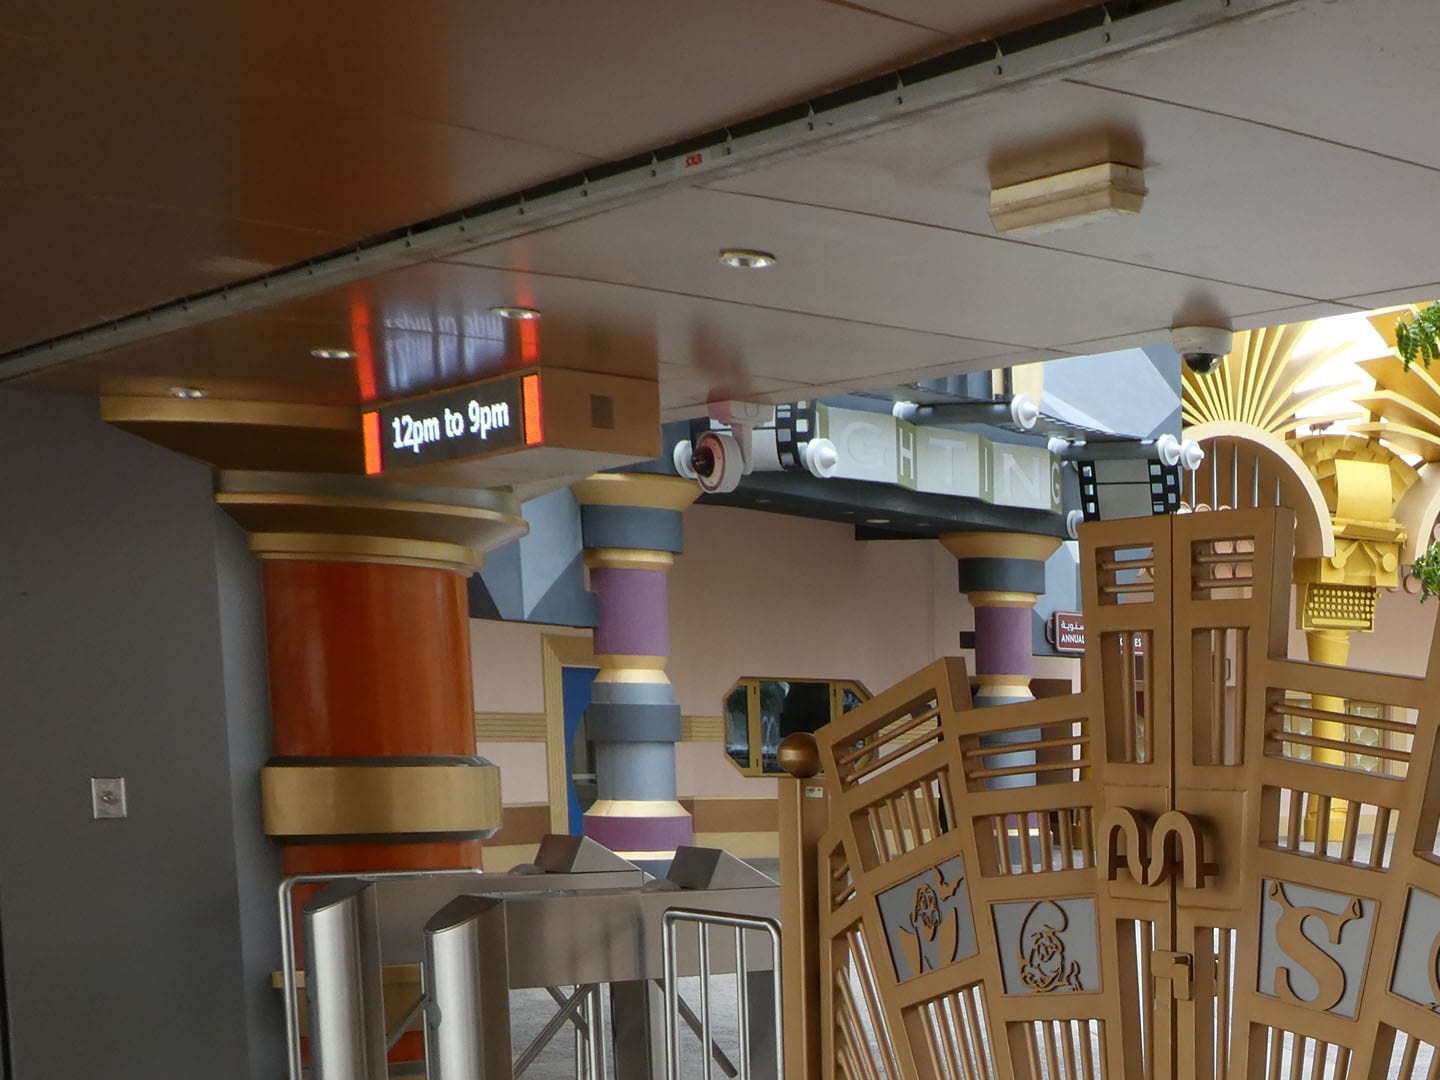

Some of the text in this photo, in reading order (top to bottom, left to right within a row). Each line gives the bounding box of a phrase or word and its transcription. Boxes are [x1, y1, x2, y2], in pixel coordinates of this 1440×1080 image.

[392, 400, 510, 452] 12pm to 9pm
